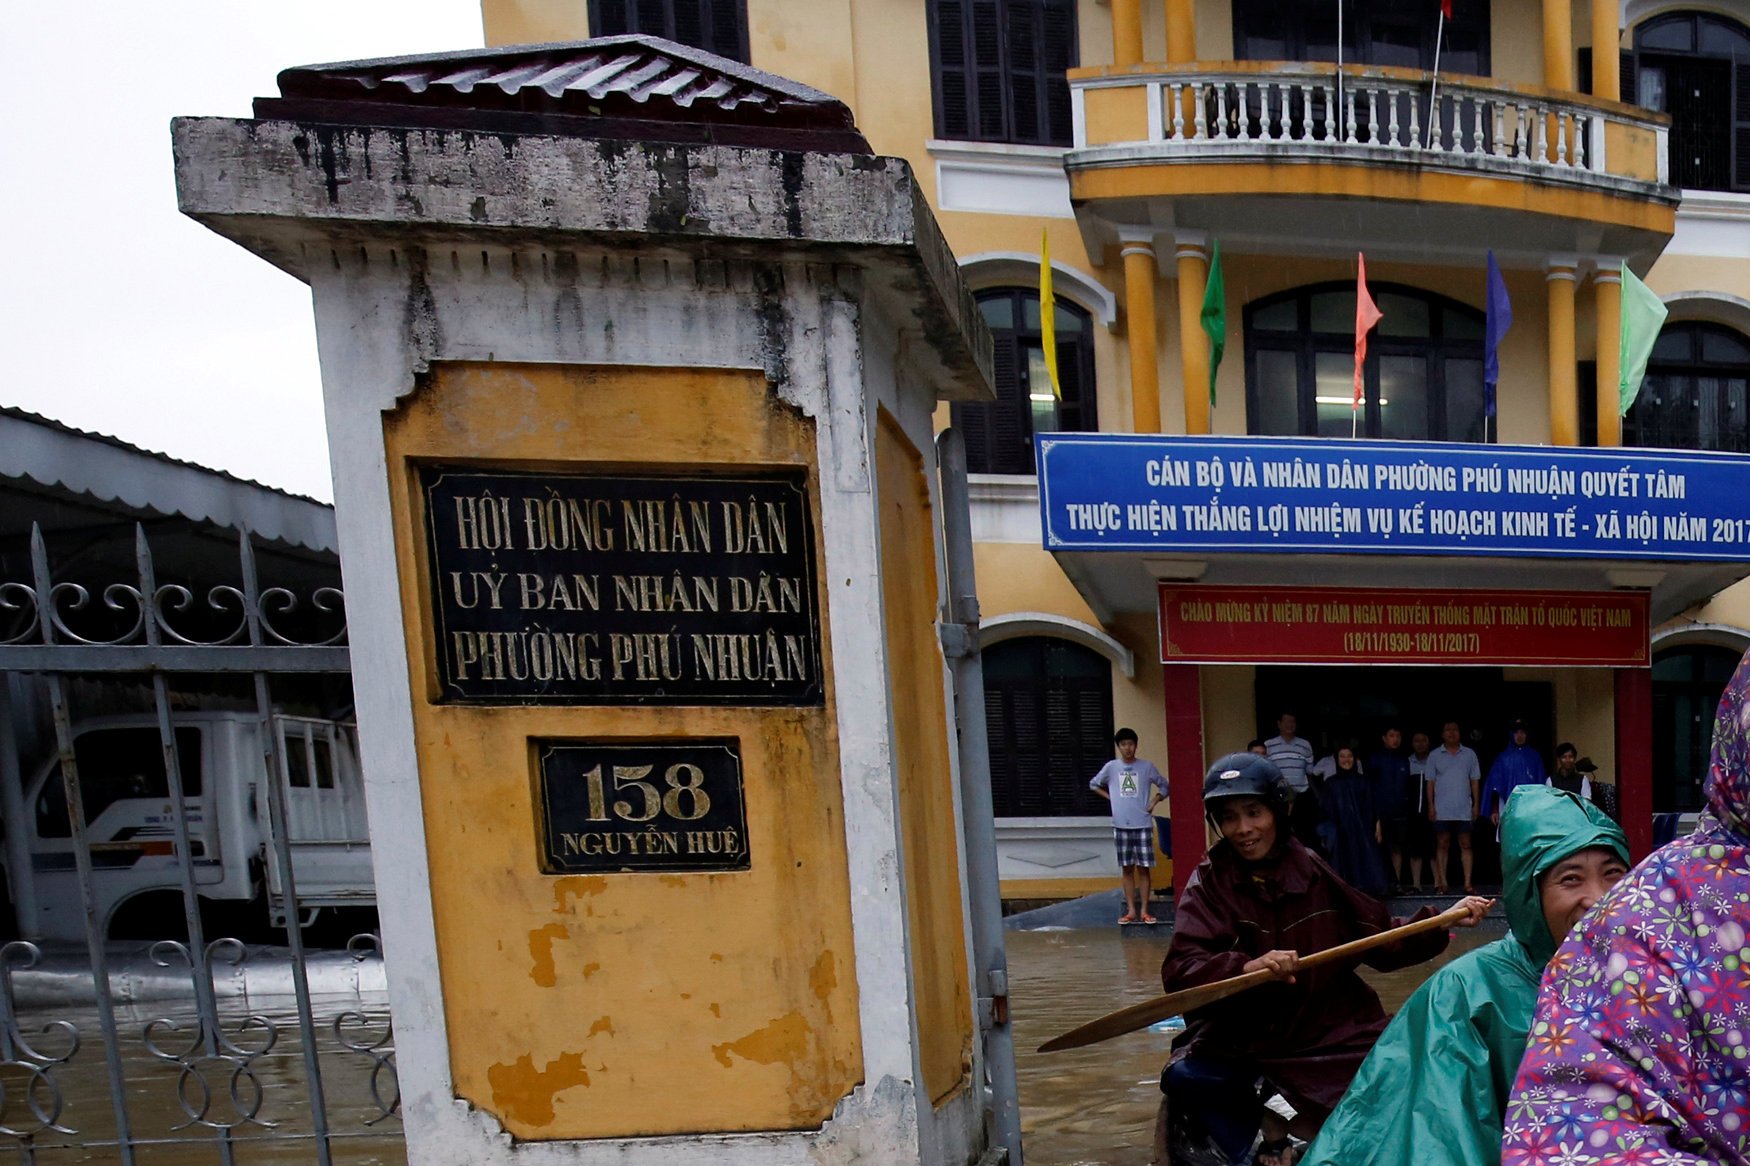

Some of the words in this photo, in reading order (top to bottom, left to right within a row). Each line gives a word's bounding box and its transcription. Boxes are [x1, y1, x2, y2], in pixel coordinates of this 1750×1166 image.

[1146, 455, 1190, 487] CÁN
[1196, 456, 1225, 492] BỘ
[1230, 456, 1257, 487] VÀ
[1262, 457, 1321, 488] NHÂN
[1326, 458, 1369, 489] DÂN
[1375, 460, 1456, 492] PHƯỜNG
[1462, 463, 1502, 493] PHÚ
[1507, 465, 1575, 500] NHUẬN
[1580, 465, 1640, 498] QUYẾT
[1645, 469, 1686, 499] TÂM
[453, 489, 515, 556] HỘI
[523, 486, 615, 551] ĐỒNG
[623, 492, 711, 553] NHÂN
[721, 494, 788, 554] DÂN
[1066, 502, 1121, 536] THỰC
[1127, 500, 1177, 536] HIỆN
[1182, 496, 1251, 532] THẮNG
[1257, 504, 1288, 537] LỢI
[1295, 502, 1361, 538] NHIỆM
[1367, 508, 1393, 539] VỤ
[1400, 501, 1425, 534] KẾ
[1430, 509, 1496, 540] HOẠCH
[1502, 511, 1549, 537] KINH
[1554, 505, 1577, 537] TẾ
[1595, 510, 1621, 539] XÃ
[1626, 510, 1658, 545] HỘI
[1664, 512, 1707, 542] NĂM
[516, 573, 600, 611] BAN
[612, 569, 719, 612] NHÂN
[728, 570, 801, 613] DÂN
[1306, 604, 1319, 623] 87
[1606, 608, 1631, 627] NAM
[452, 622, 603, 681] PHƯỜNG
[609, 625, 682, 681] PHÚ
[690, 627, 806, 687] NHUẬN
[582, 763, 711, 822] 158
[560, 824, 679, 856] NGUYỄN
[686, 826, 740, 858] HUỆ
